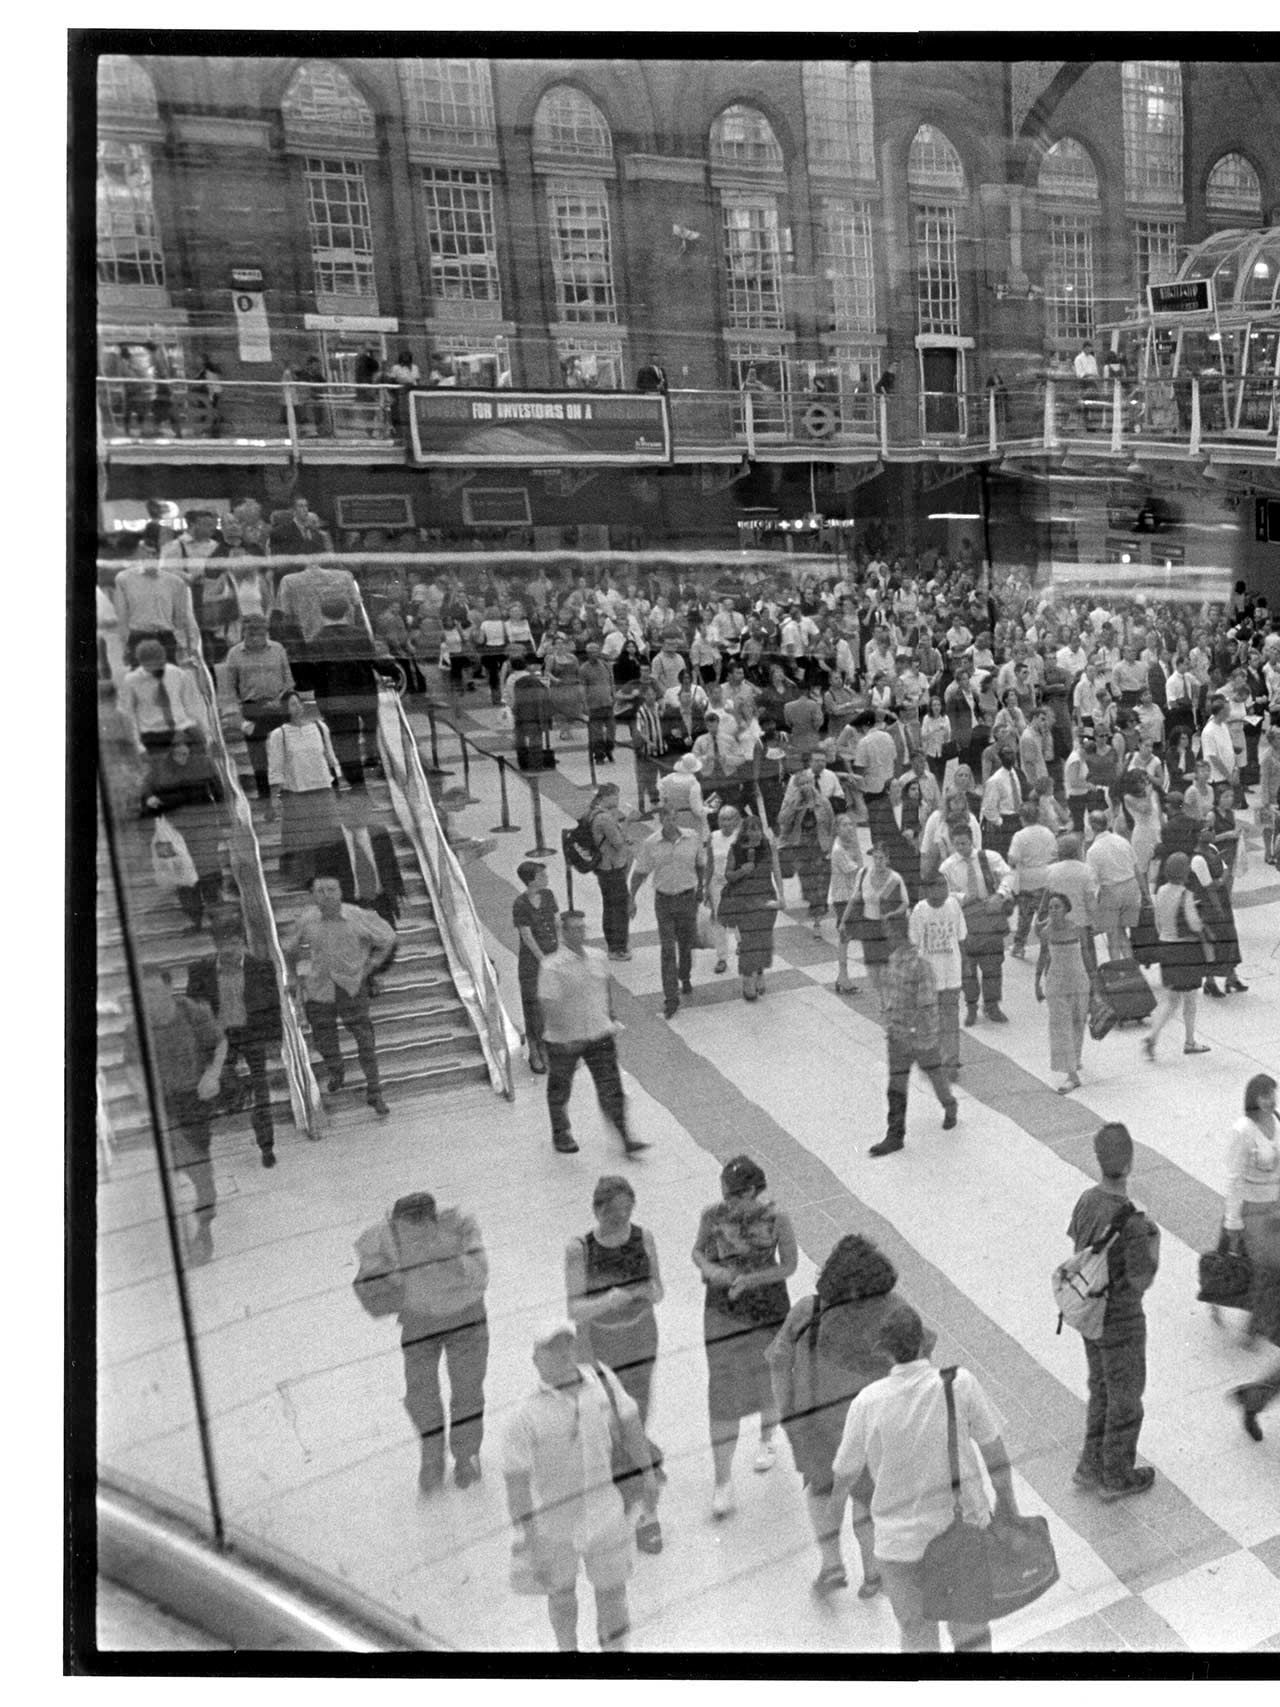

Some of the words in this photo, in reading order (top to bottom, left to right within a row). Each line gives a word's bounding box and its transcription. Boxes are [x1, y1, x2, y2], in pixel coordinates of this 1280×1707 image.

[472, 402, 492, 419] FOR
[497, 403, 564, 419] INVESTORS
[567, 404, 582, 419] ON
[585, 404, 592, 419] A
